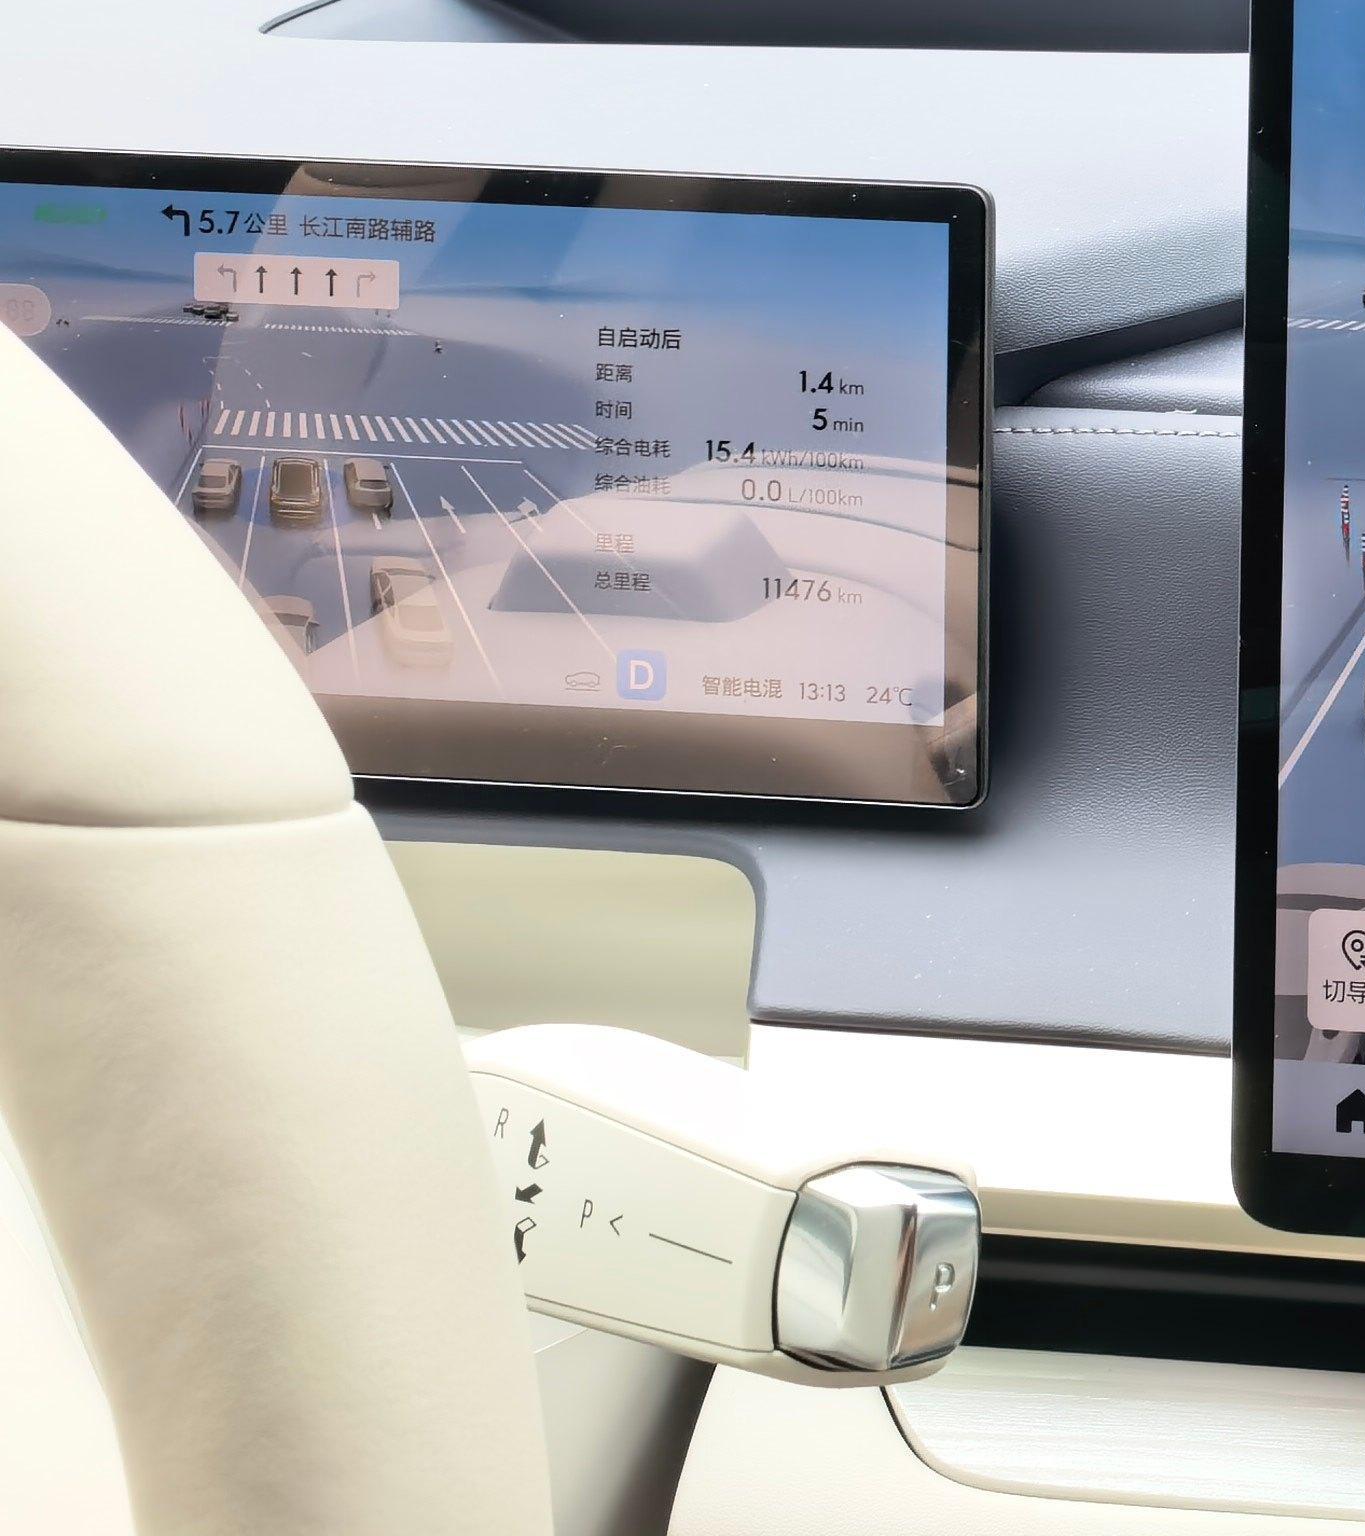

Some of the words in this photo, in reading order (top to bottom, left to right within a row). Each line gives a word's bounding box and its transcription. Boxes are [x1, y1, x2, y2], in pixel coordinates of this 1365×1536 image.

[199, 211, 240, 235] 5.7
[244, 212, 288, 236] 公里
[300, 216, 437, 242] 长江南路辅路
[598, 326, 682, 350] 自启动后
[595, 363, 633, 383] 距离
[799, 370, 834, 394] 1.4
[839, 378, 865, 395] km
[595, 400, 632, 420] 时间
[812, 408, 828, 431] 5
[833, 417, 864, 432] min
[595, 437, 671, 458] 综合电耗
[706, 440, 756, 464] 15.4
[762, 448, 864, 471] kWh/100km
[594, 473, 671, 494] 综合油耗
[741, 479, 781, 501] 0.0
[789, 487, 863, 507] L/100km
[595, 571, 651, 591] 总里程
[762, 577, 832, 603] 11476
[838, 589, 862, 605] km
[630, 660, 654, 690] D
[702, 674, 783, 699] 智能电混
[799, 683, 845, 702] 13:13
[494, 1107, 509, 1138] R
[580, 1199, 593, 1228] P
[928, 1262, 955, 1312] P
